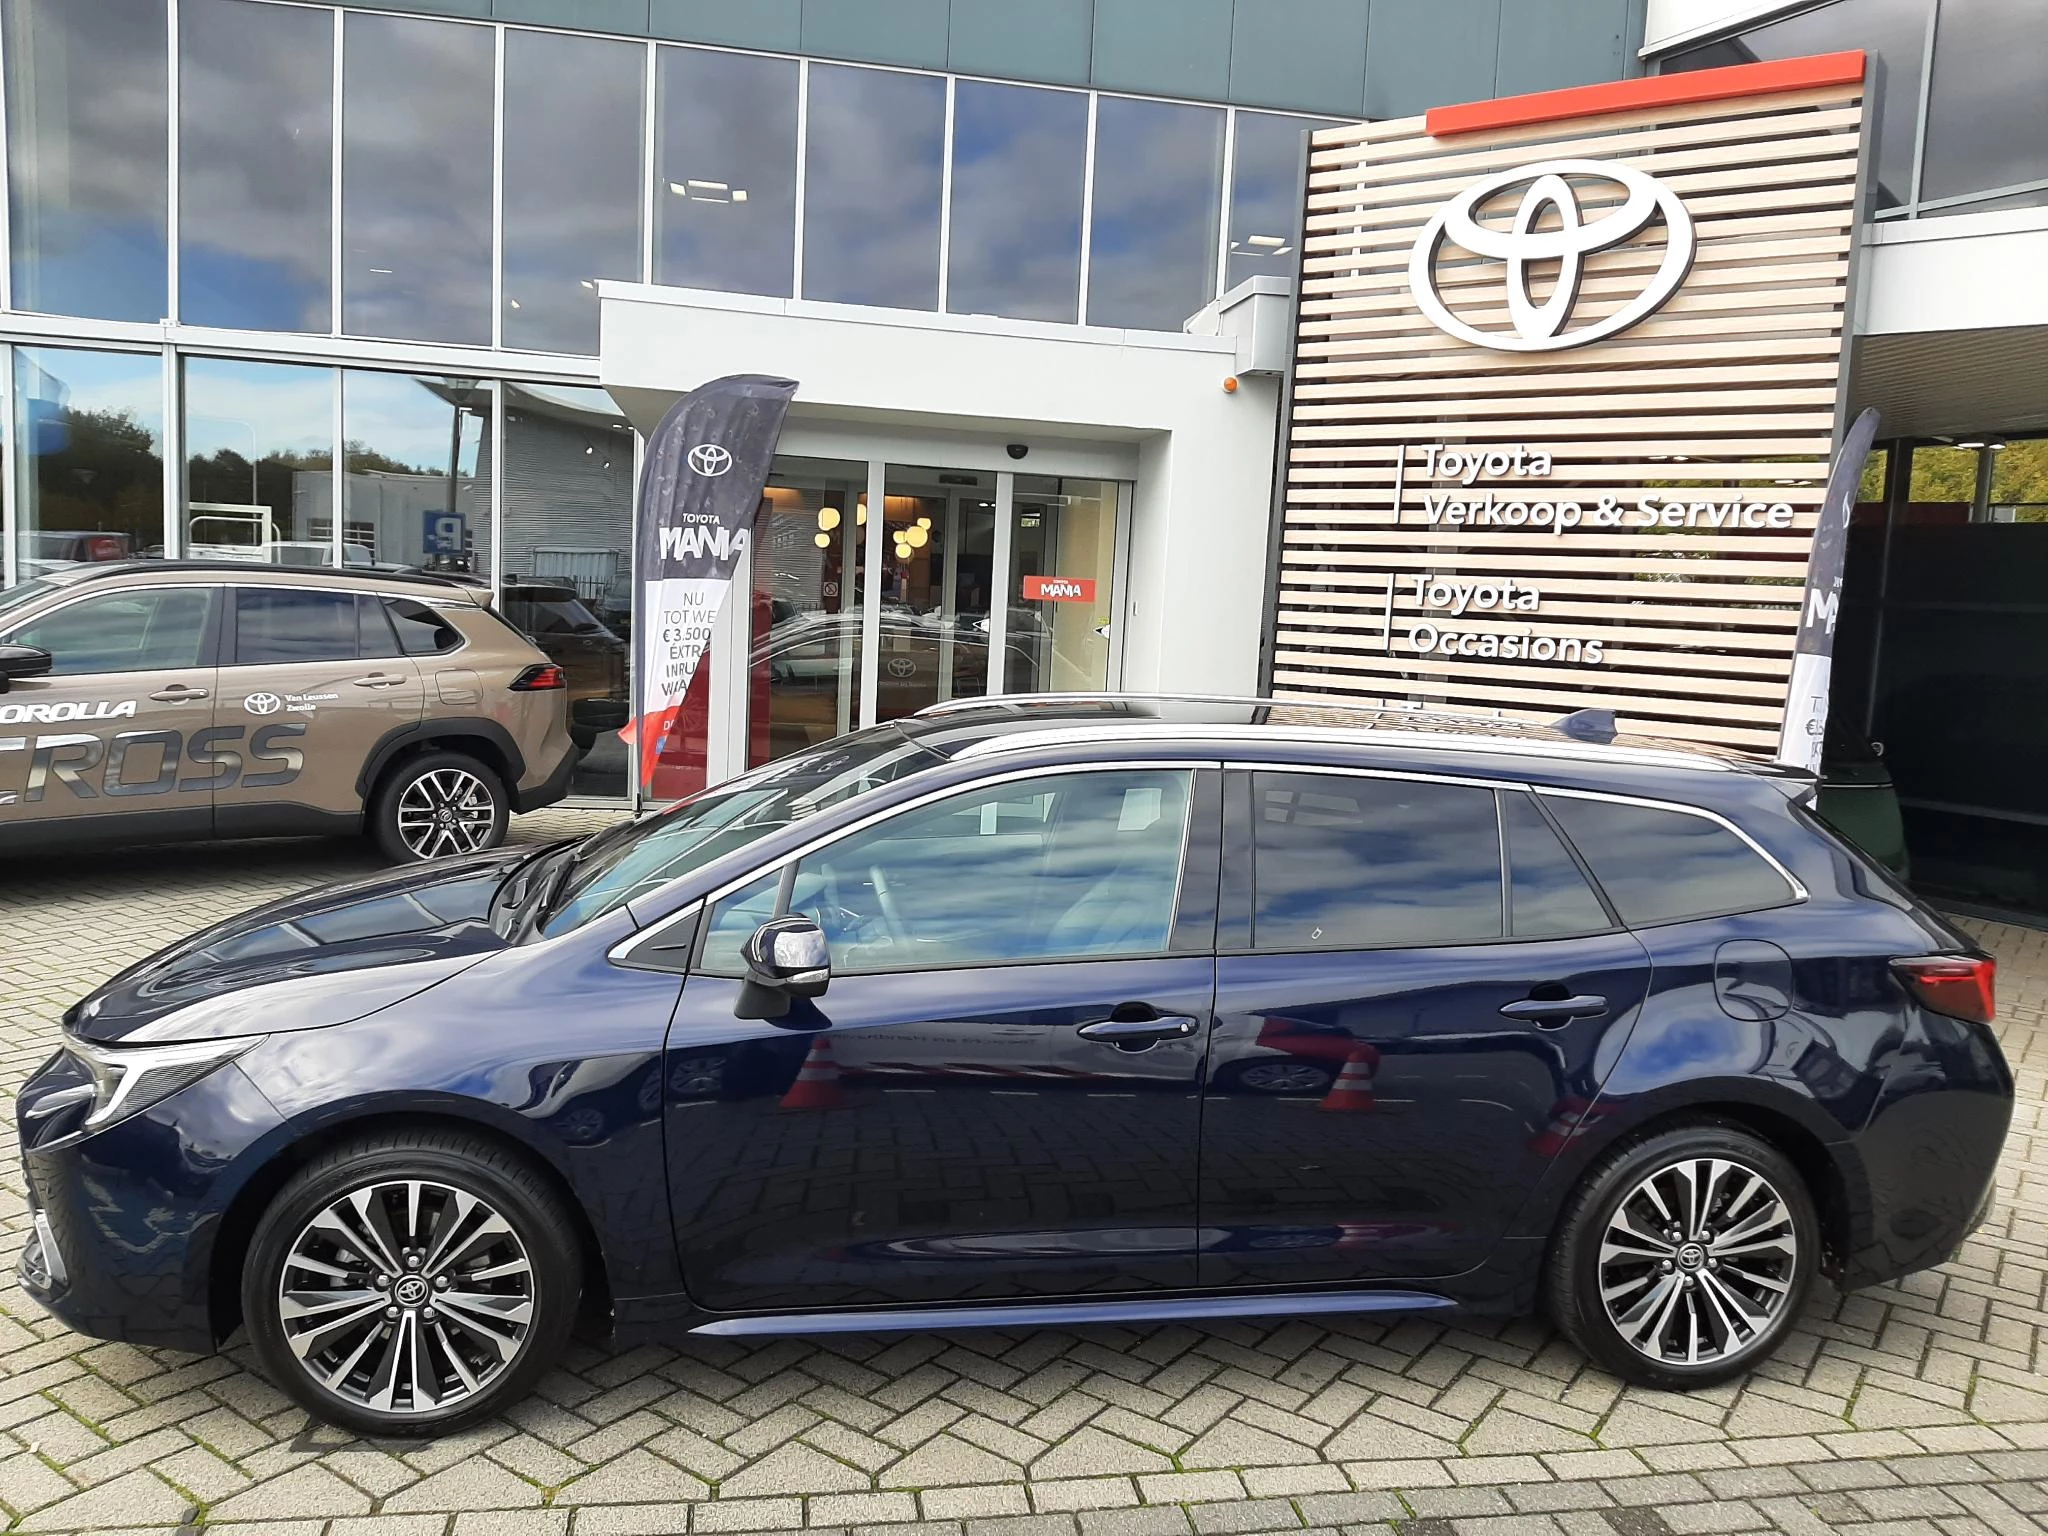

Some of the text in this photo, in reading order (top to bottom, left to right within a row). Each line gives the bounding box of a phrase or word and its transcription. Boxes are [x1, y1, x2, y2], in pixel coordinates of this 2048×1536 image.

[1421, 444, 1552, 485] Toyota
[682, 513, 720, 524] TOYOTA
[1424, 492, 1794, 535] Verkoop & Service
[659, 525, 749, 561] MANIA
[684, 592, 704, 606] NU
[1041, 584, 1081, 597] MANIA
[1410, 574, 1540, 616] Toyota
[664, 610, 688, 624] TOT
[663, 627, 711, 642] € 3.500
[1408, 623, 1604, 664] Occasions
[284, 694, 302, 702] Van
[0, 700, 137, 724] OROLLA
